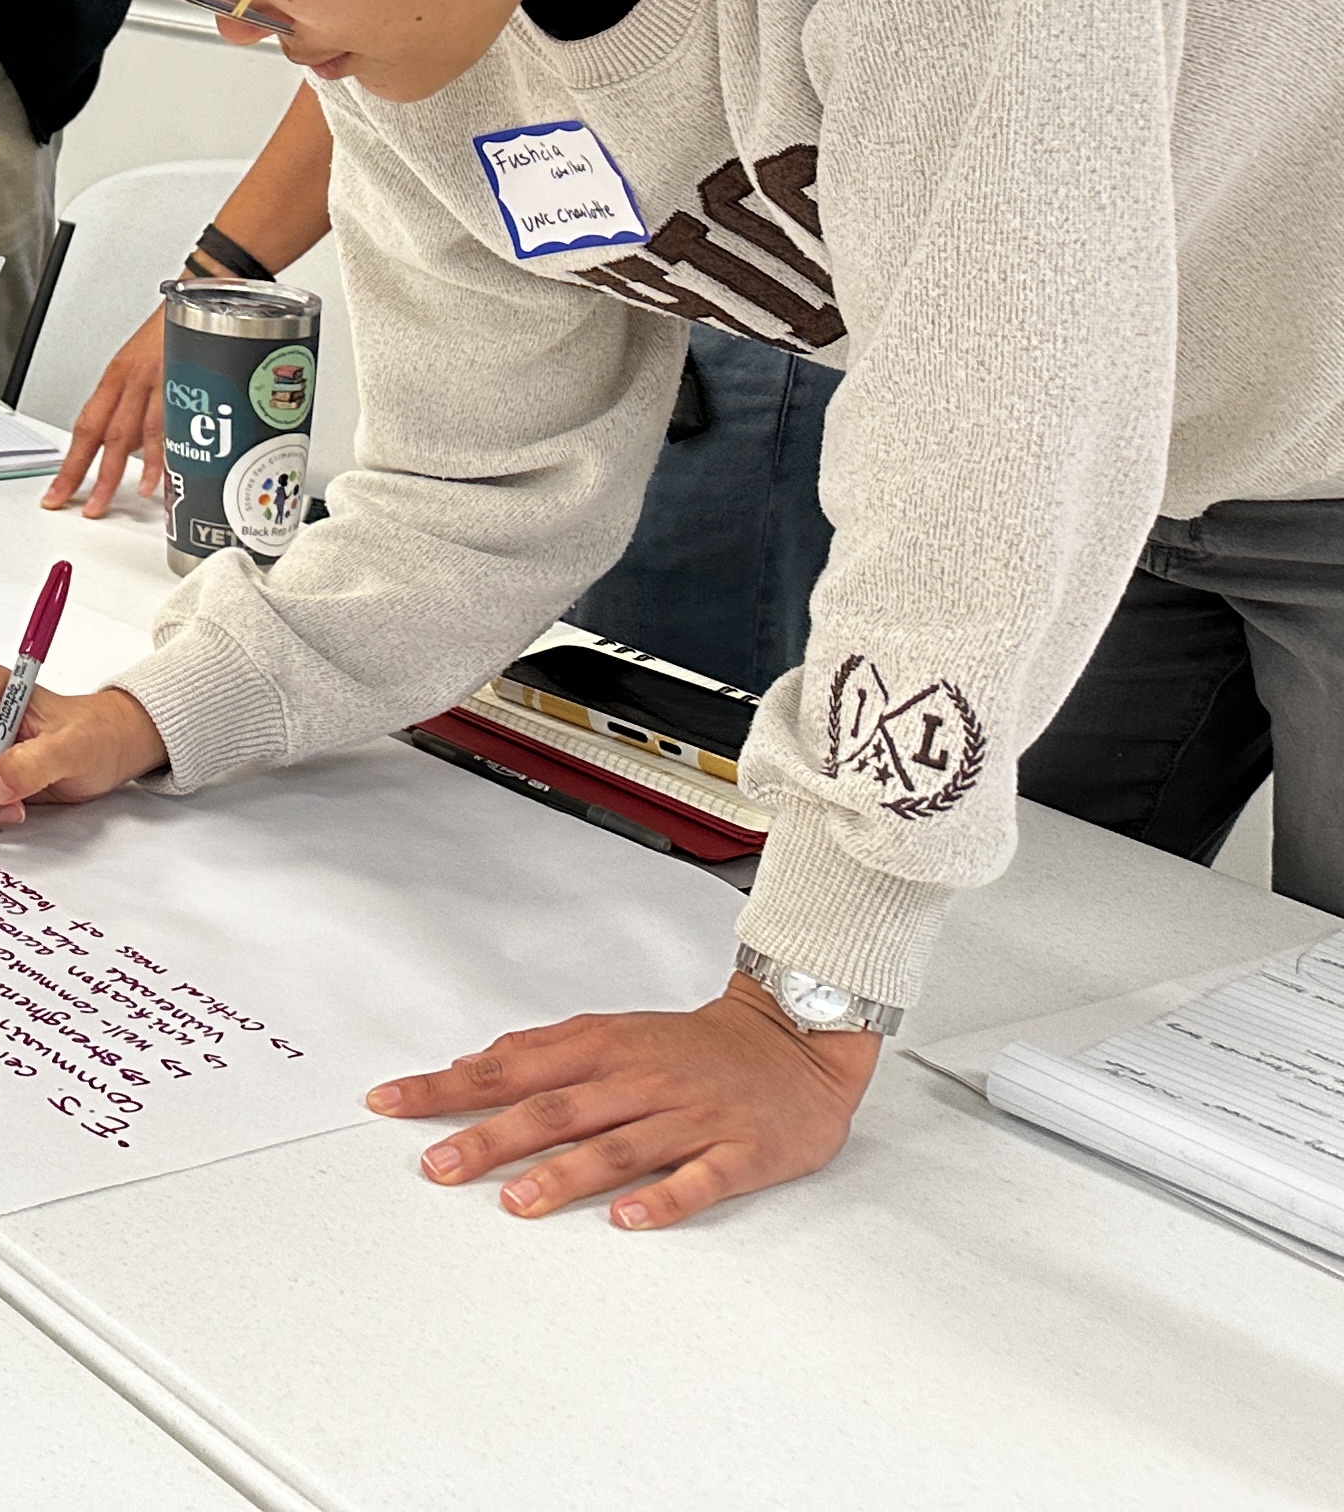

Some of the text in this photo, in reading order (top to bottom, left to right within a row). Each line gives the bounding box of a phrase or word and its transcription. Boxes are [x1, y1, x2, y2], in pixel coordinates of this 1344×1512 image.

[520, 212, 556, 233] UNC
[166, 378, 211, 414] esa
[190, 403, 233, 459] ej
[912, 712, 949, 772] L
[41, 925, 90, 956] aka
[68, 920, 105, 938] at
[115, 945, 168, 975] mass
[67, 965, 196, 1046] unification
[171, 982, 265, 1031] critical
